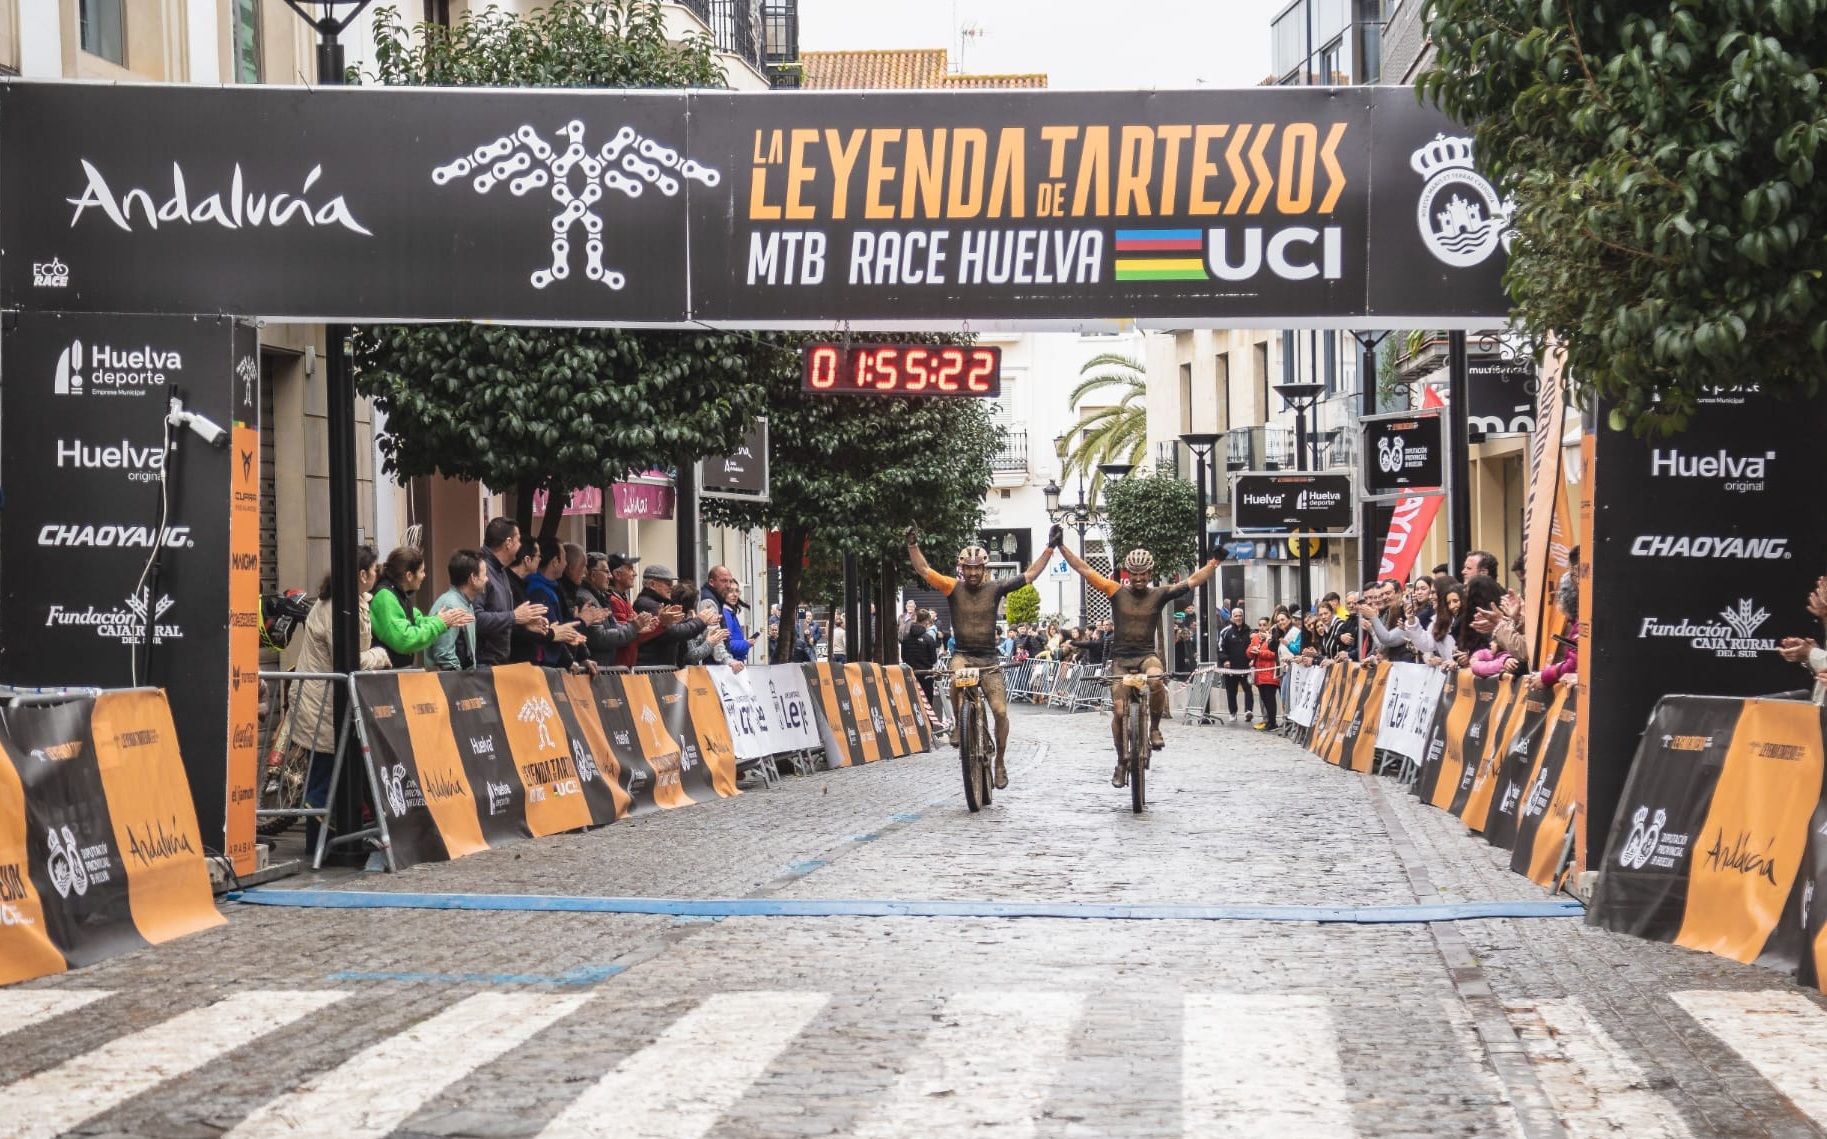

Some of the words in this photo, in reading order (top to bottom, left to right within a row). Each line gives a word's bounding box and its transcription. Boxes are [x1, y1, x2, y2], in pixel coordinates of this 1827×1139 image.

[753, 128, 783, 164] LA
[749, 127, 1025, 221] LEYENDA
[1042, 122, 1349, 217] TARTESSOS
[66, 158, 374, 236] Andalucía
[1036, 182, 1066, 217] DE
[747, 231, 825, 285] MTB
[849, 230, 949, 285] RACE
[958, 229, 1104, 284] HUELVA
[1208, 227, 1342, 280] UCI
[33, 275, 69, 288] RACE
[92, 345, 182, 370] Huelva
[92, 368, 165, 387] deporte
[57, 439, 165, 469] Huelva
[1651, 449, 1765, 478] Huelva
[1243, 493, 1282, 505] Huelva
[1309, 491, 1341, 500] Huelva
[1724, 481, 1765, 493] original
[1631, 535, 1787, 559] CHAOYANG
[45, 604, 137, 627] Fundación
[97, 624, 133, 637] CAJA
[134, 624, 183, 637] RRAL
[1637, 617, 1732, 640] Fundación
[1691, 638, 1727, 650] CAJA
[1730, 638, 1778, 650] RURAL
[1716, 650, 1735, 658] DEL
[1738, 650, 1757, 658] SUR
[125, 815, 195, 868] Andalucía
